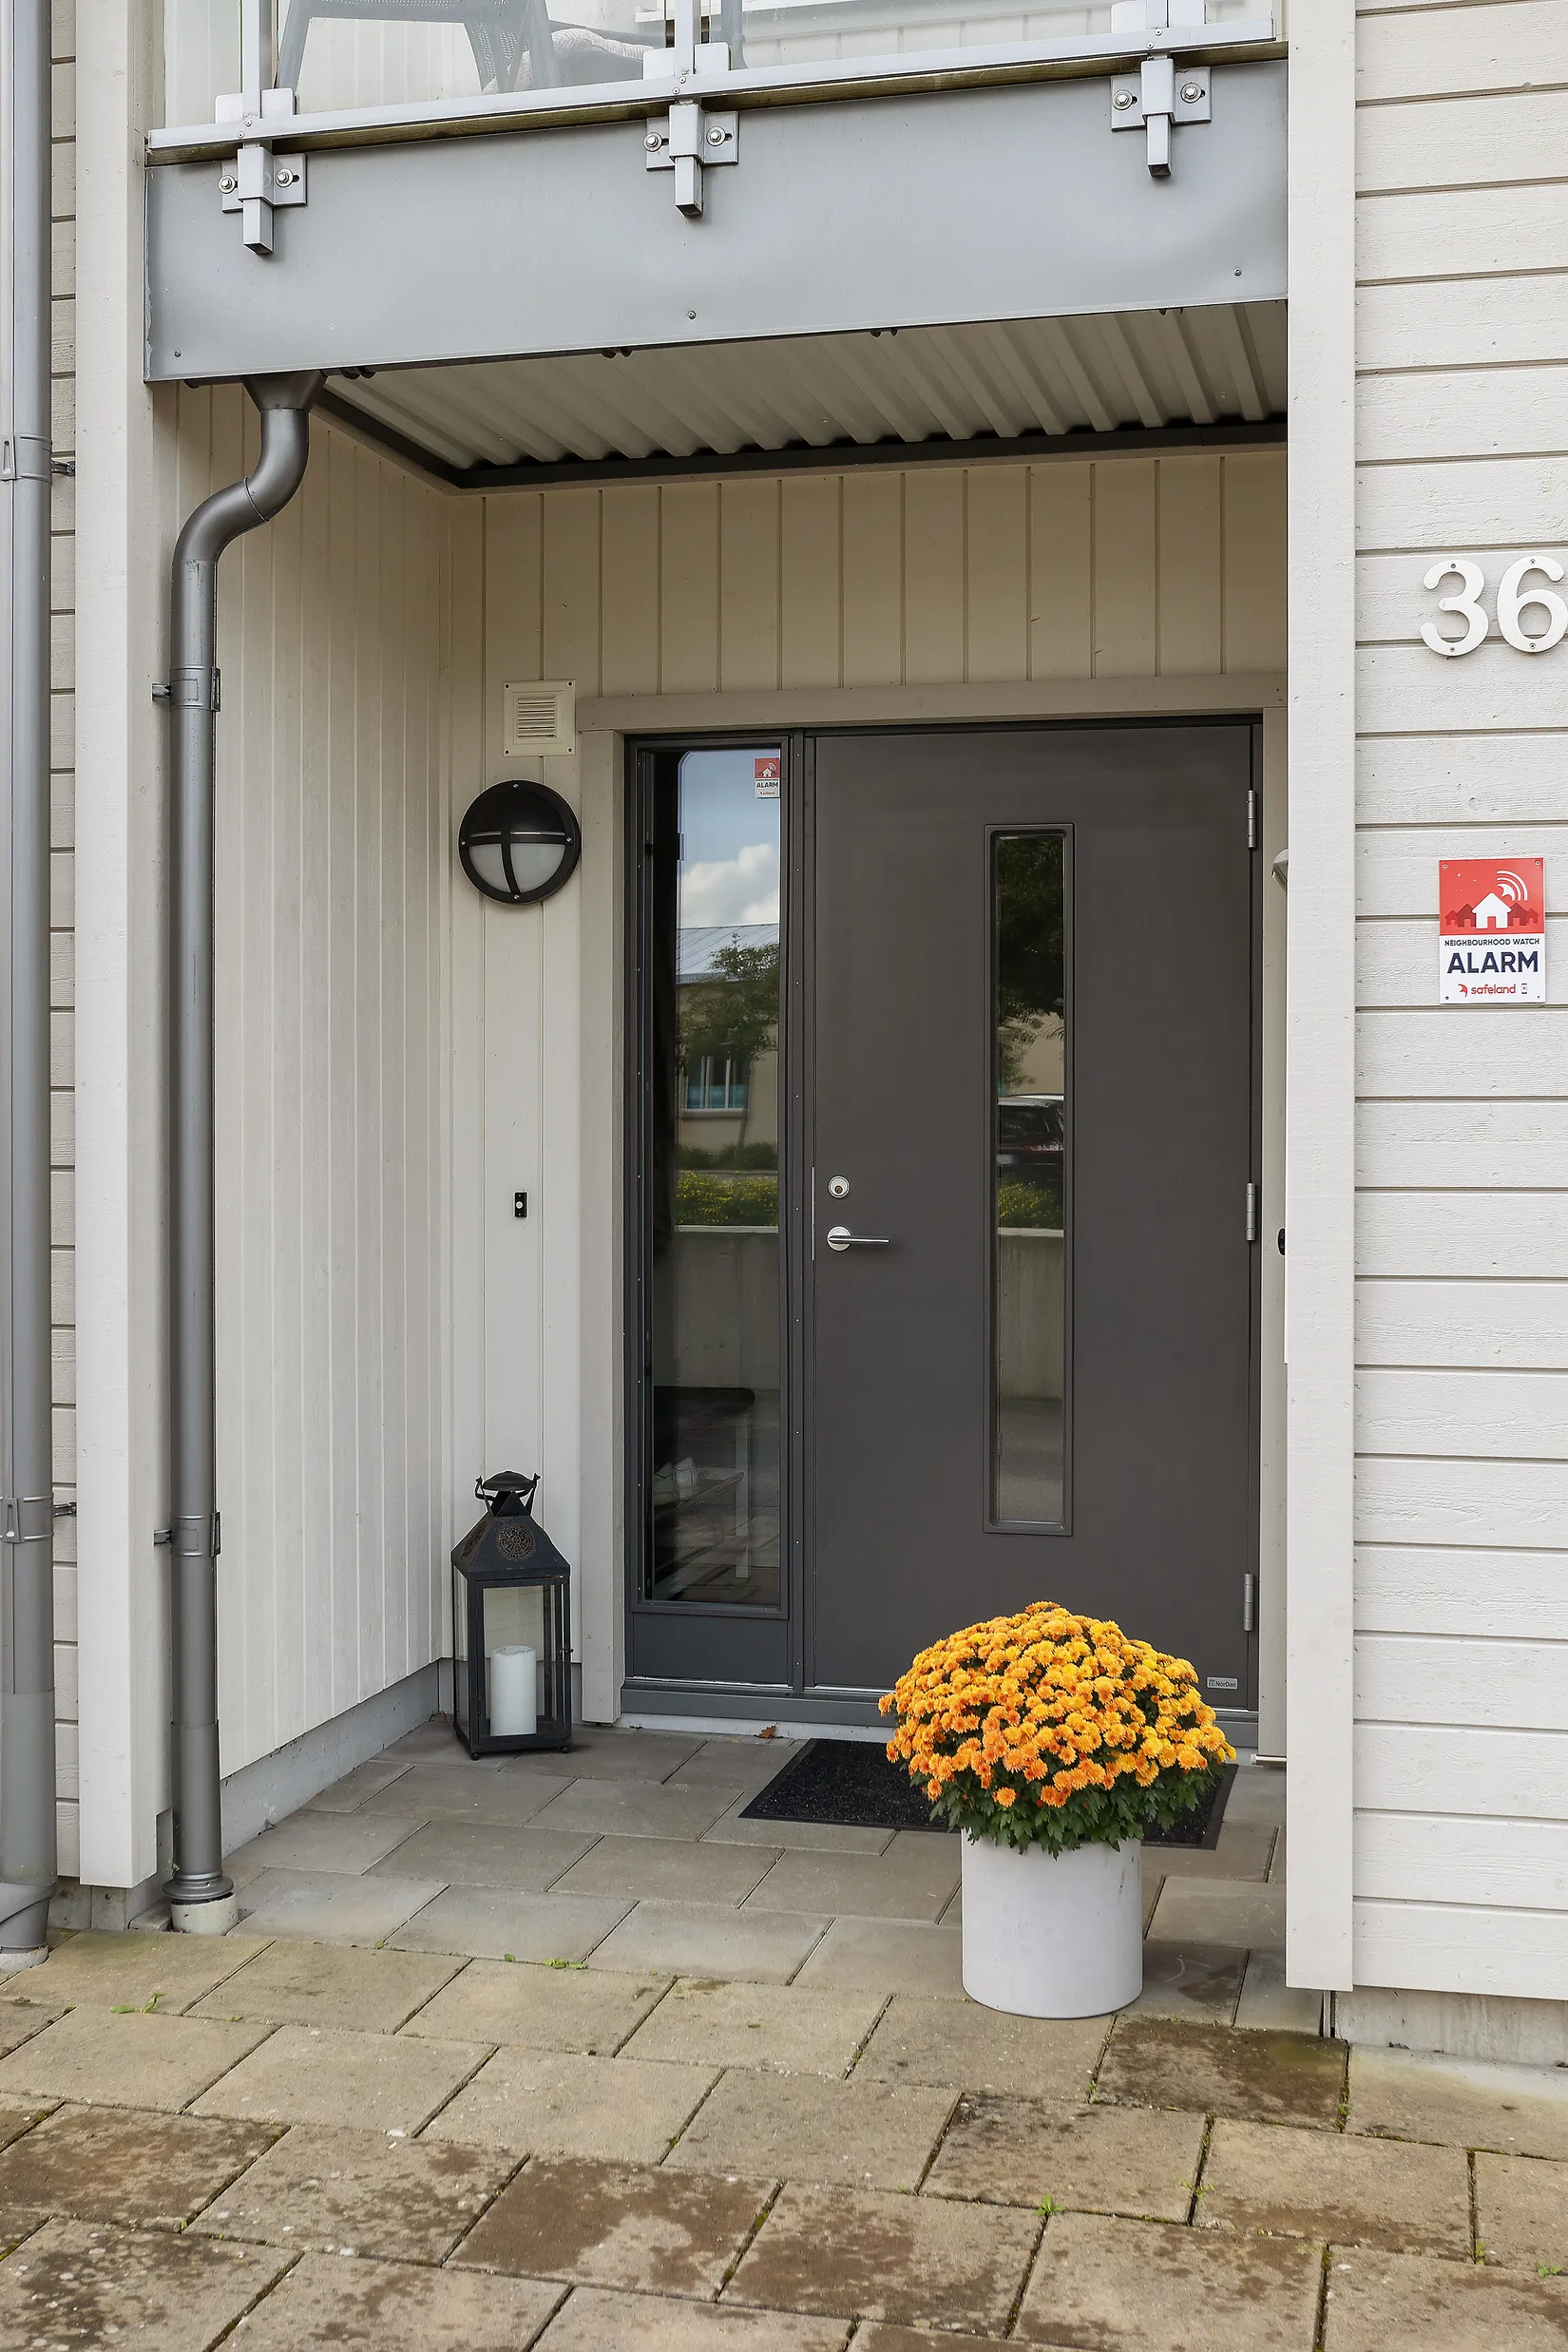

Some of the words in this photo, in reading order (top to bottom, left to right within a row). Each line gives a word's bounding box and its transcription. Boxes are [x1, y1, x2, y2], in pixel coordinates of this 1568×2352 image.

[1420, 556, 1568, 656] 36
[1447, 951, 1539, 974] ALARM
[1471, 984, 1516, 995] safeland
